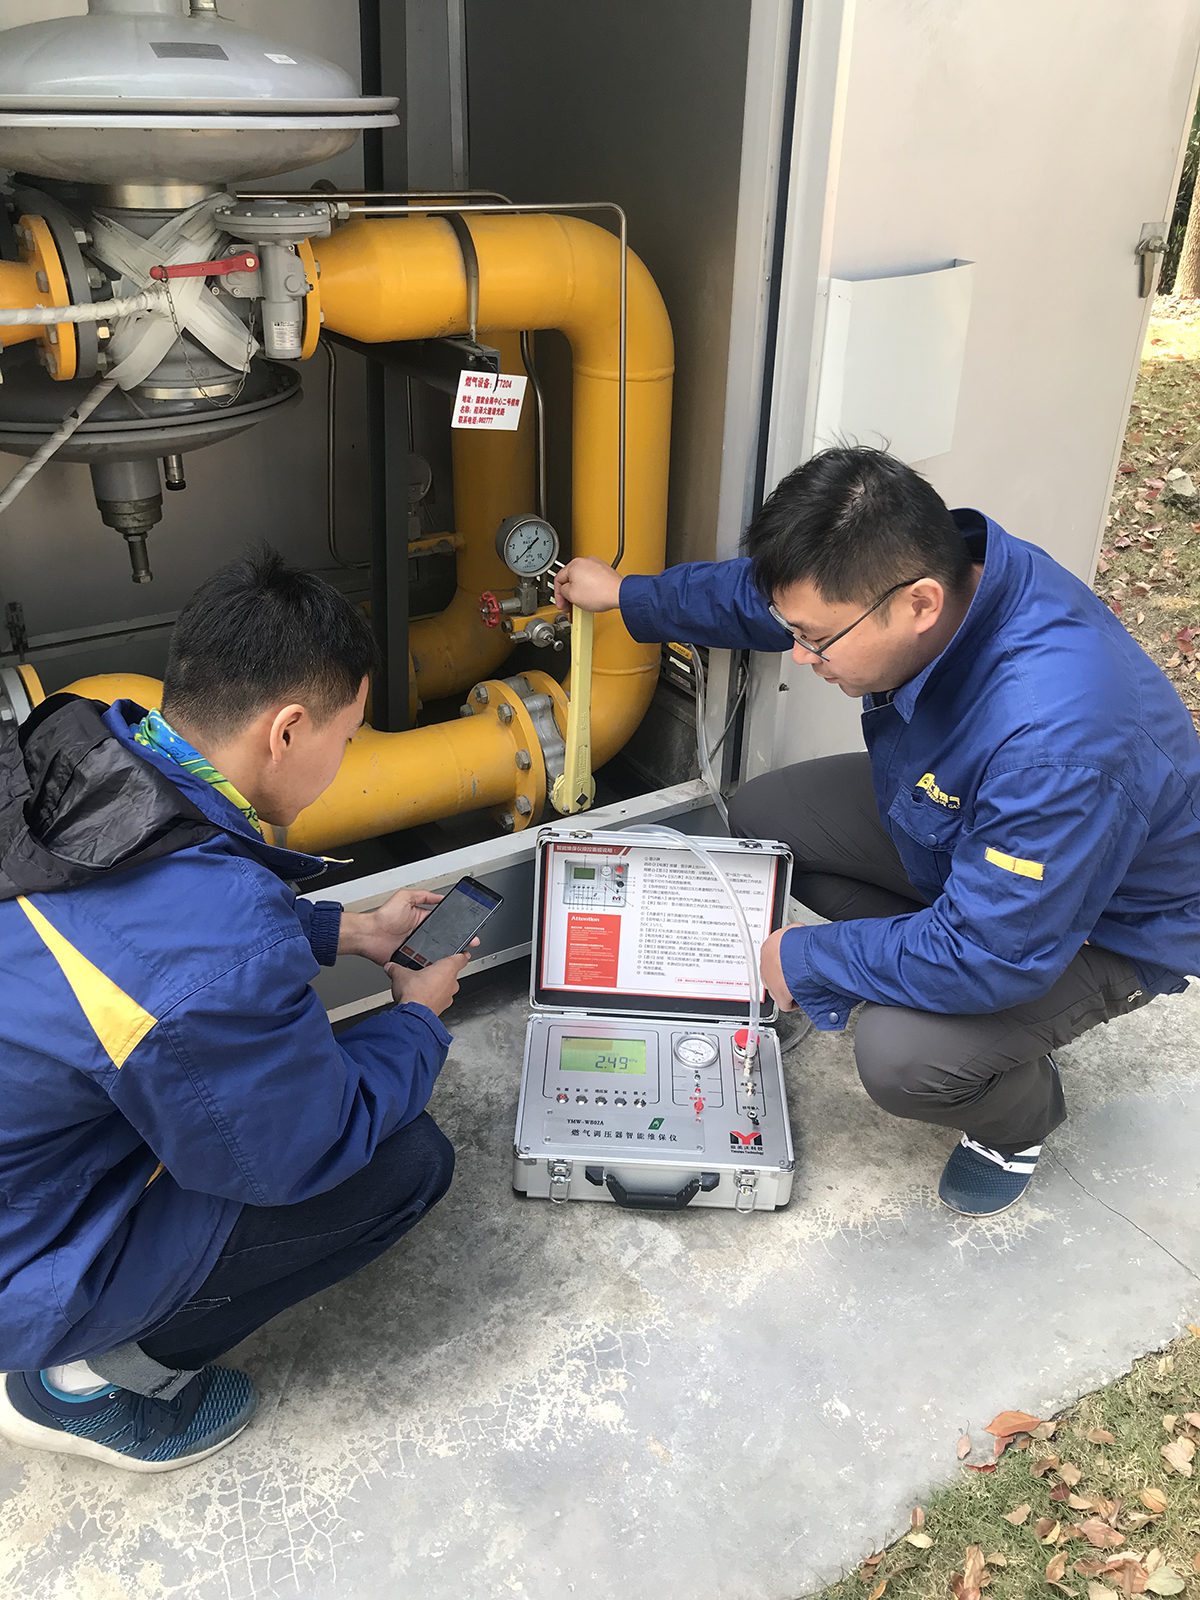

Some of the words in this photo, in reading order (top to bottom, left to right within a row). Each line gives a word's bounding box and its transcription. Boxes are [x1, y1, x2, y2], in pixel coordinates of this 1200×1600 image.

[570, 915, 600, 923] Attention
[595, 1055, 628, 1071] 2.49
[570, 1128, 678, 1142] 燃气调压器智能维保仪
